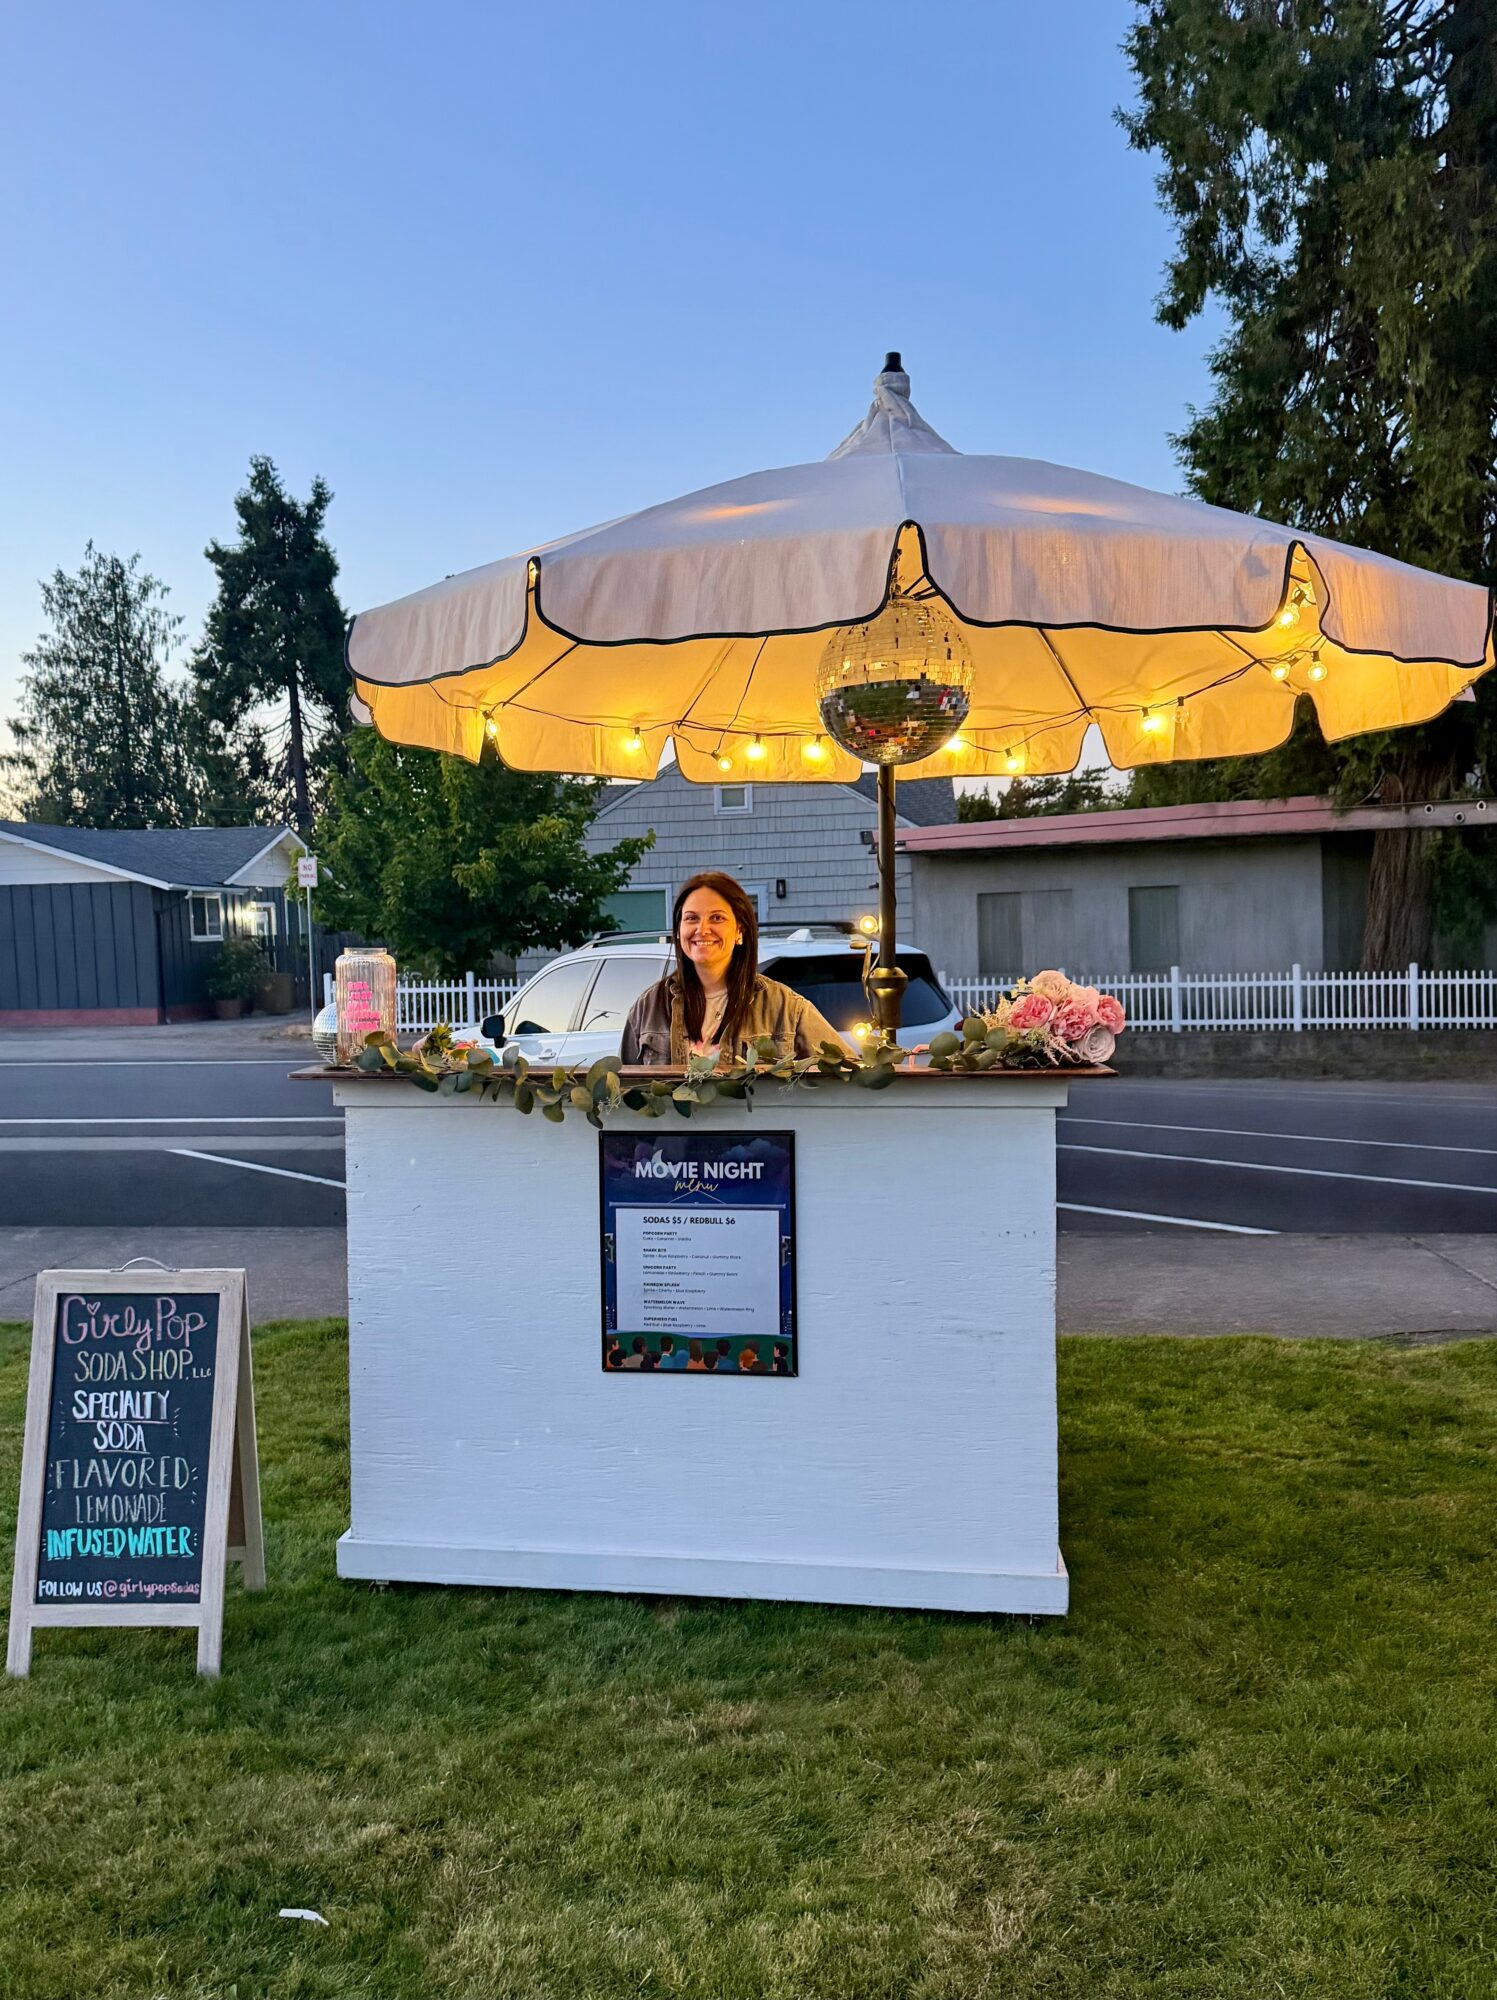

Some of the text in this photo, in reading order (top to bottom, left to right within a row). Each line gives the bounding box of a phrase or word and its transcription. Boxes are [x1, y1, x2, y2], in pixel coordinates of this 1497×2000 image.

[303, 864, 313, 872] NO
[635, 1161, 765, 1179] MOVIE NIGHT
[674, 1179, 719, 1192] menu
[643, 1216, 670, 1224] SODAS
[672, 1216, 682, 1225] $5
[690, 1217, 723, 1225] REDBULL
[726, 1217, 736, 1225] $6
[193, 1367, 212, 1379] LLC
[72, 1389, 170, 1420] SPECIALTY
[94, 1420, 147, 1452] SODA
[56, 1456, 190, 1489] FLAVORED
[76, 1492, 167, 1524] LEMONADE
[39, 1580, 83, 1597] FOLLOW
[88, 1581, 103, 1597] US
